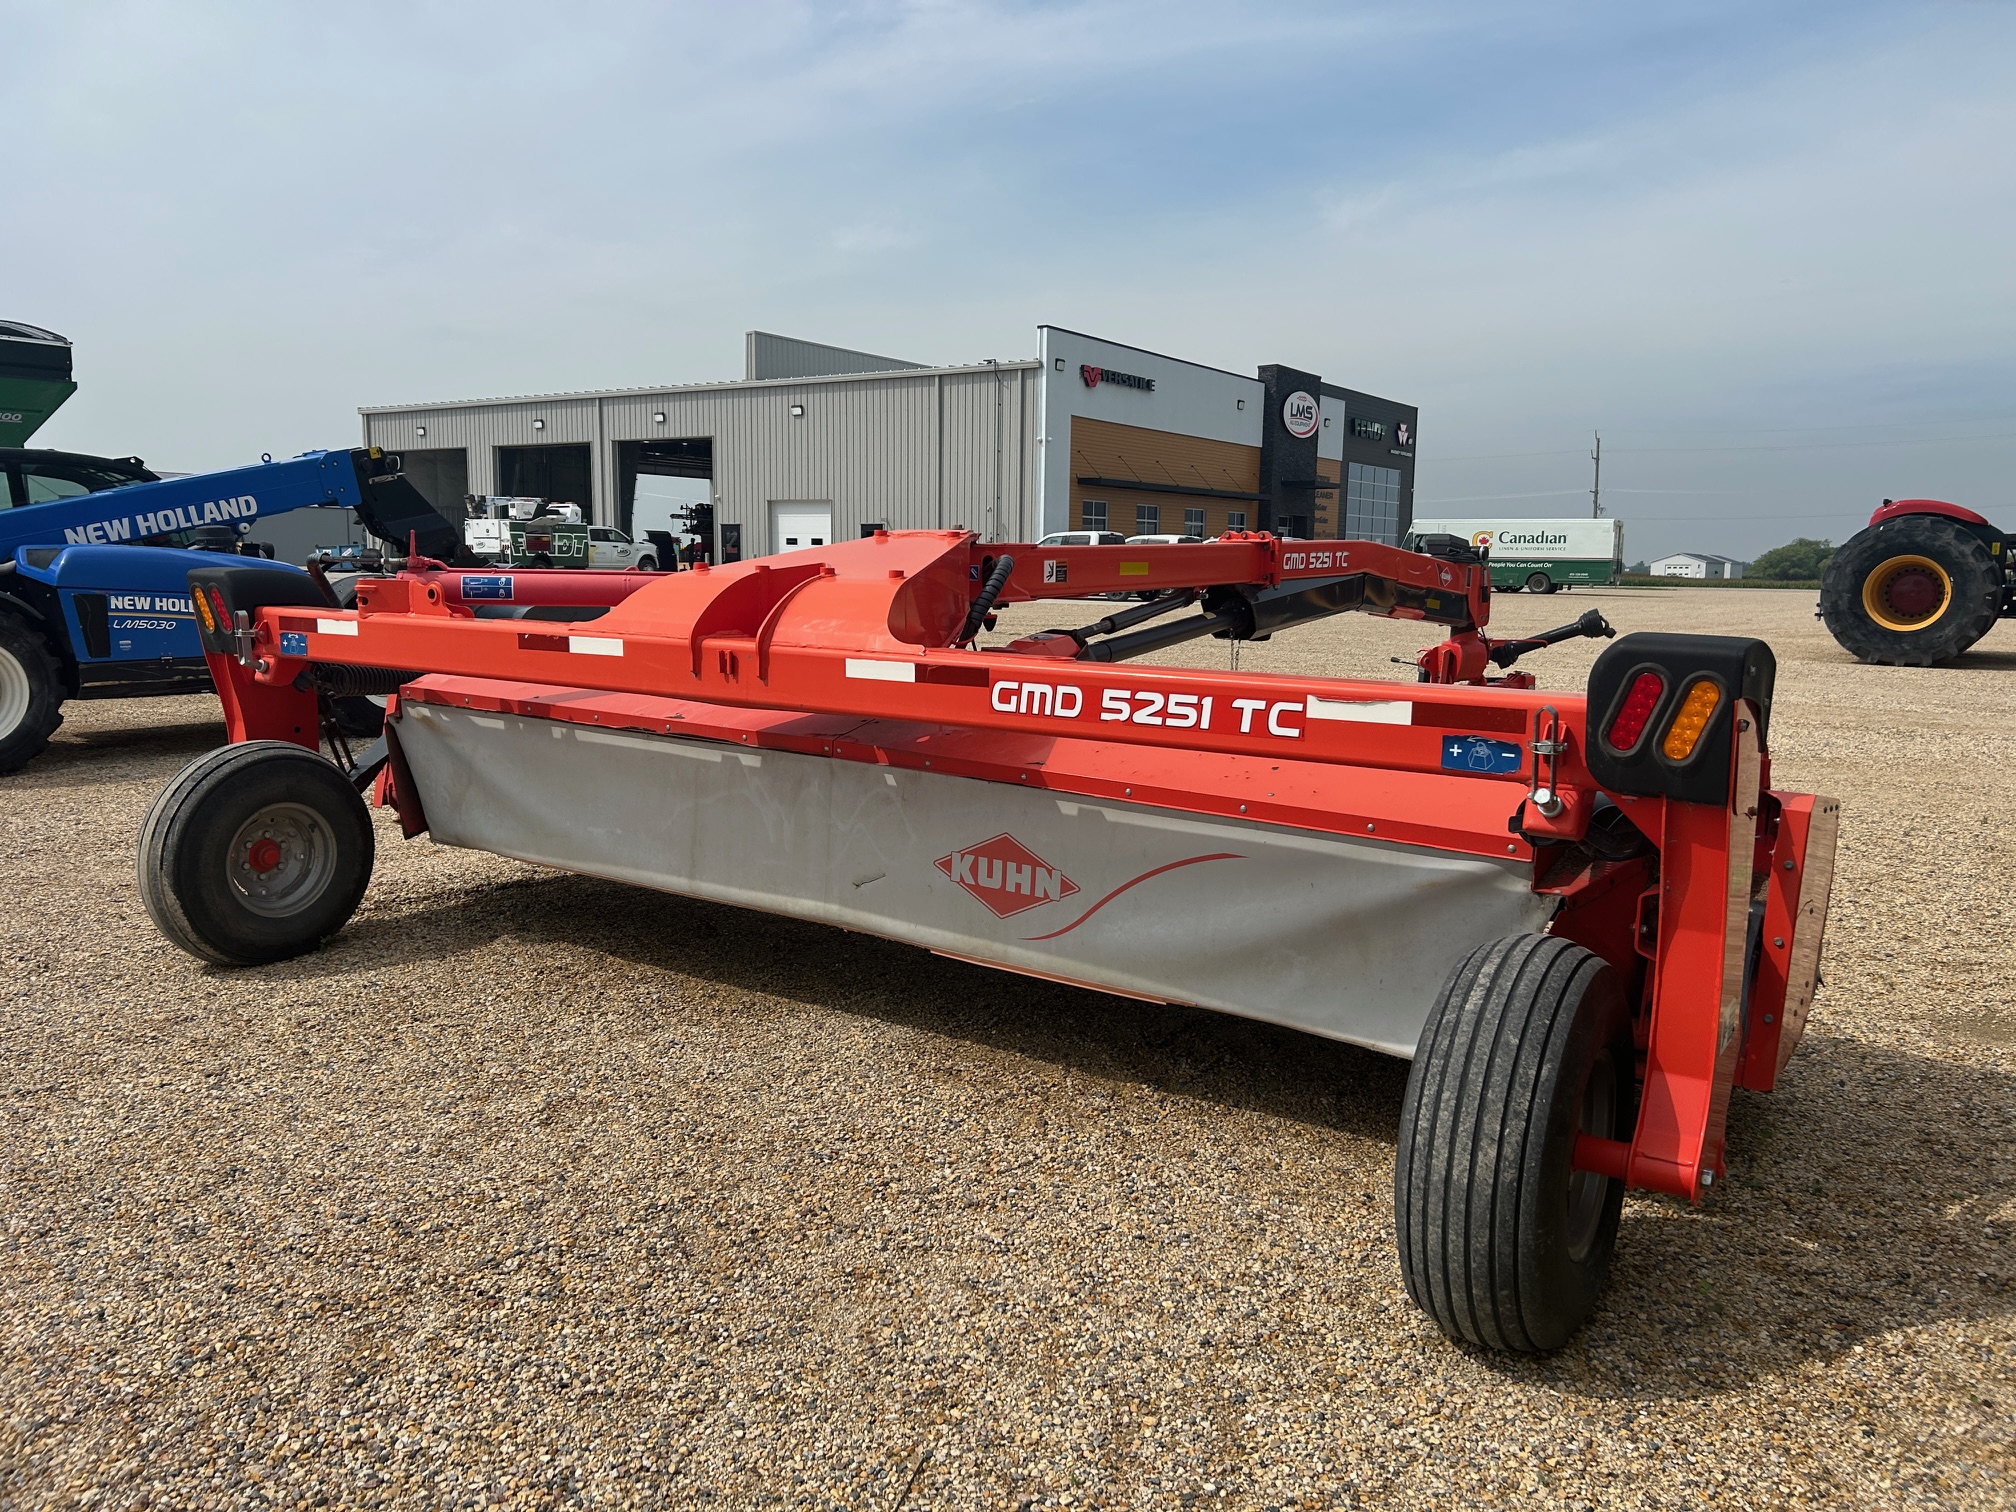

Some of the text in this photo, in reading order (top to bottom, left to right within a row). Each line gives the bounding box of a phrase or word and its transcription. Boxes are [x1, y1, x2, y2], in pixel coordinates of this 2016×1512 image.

[1102, 368, 1155, 391] VERSATILE
[0, 412, 22, 420] 00
[1290, 402, 1313, 420] LMS
[1354, 418, 1387, 441] FENDT
[64, 495, 258, 544] NEW HOLLAND
[1498, 530, 1566, 544] Canadian
[1283, 551, 1350, 570] GMD 5251 TC
[110, 595, 194, 613] NEW HOLL
[113, 619, 177, 630] LM5030
[991, 680, 1304, 738] GMD 5251 TC
[950, 851, 1062, 902] KUHN
